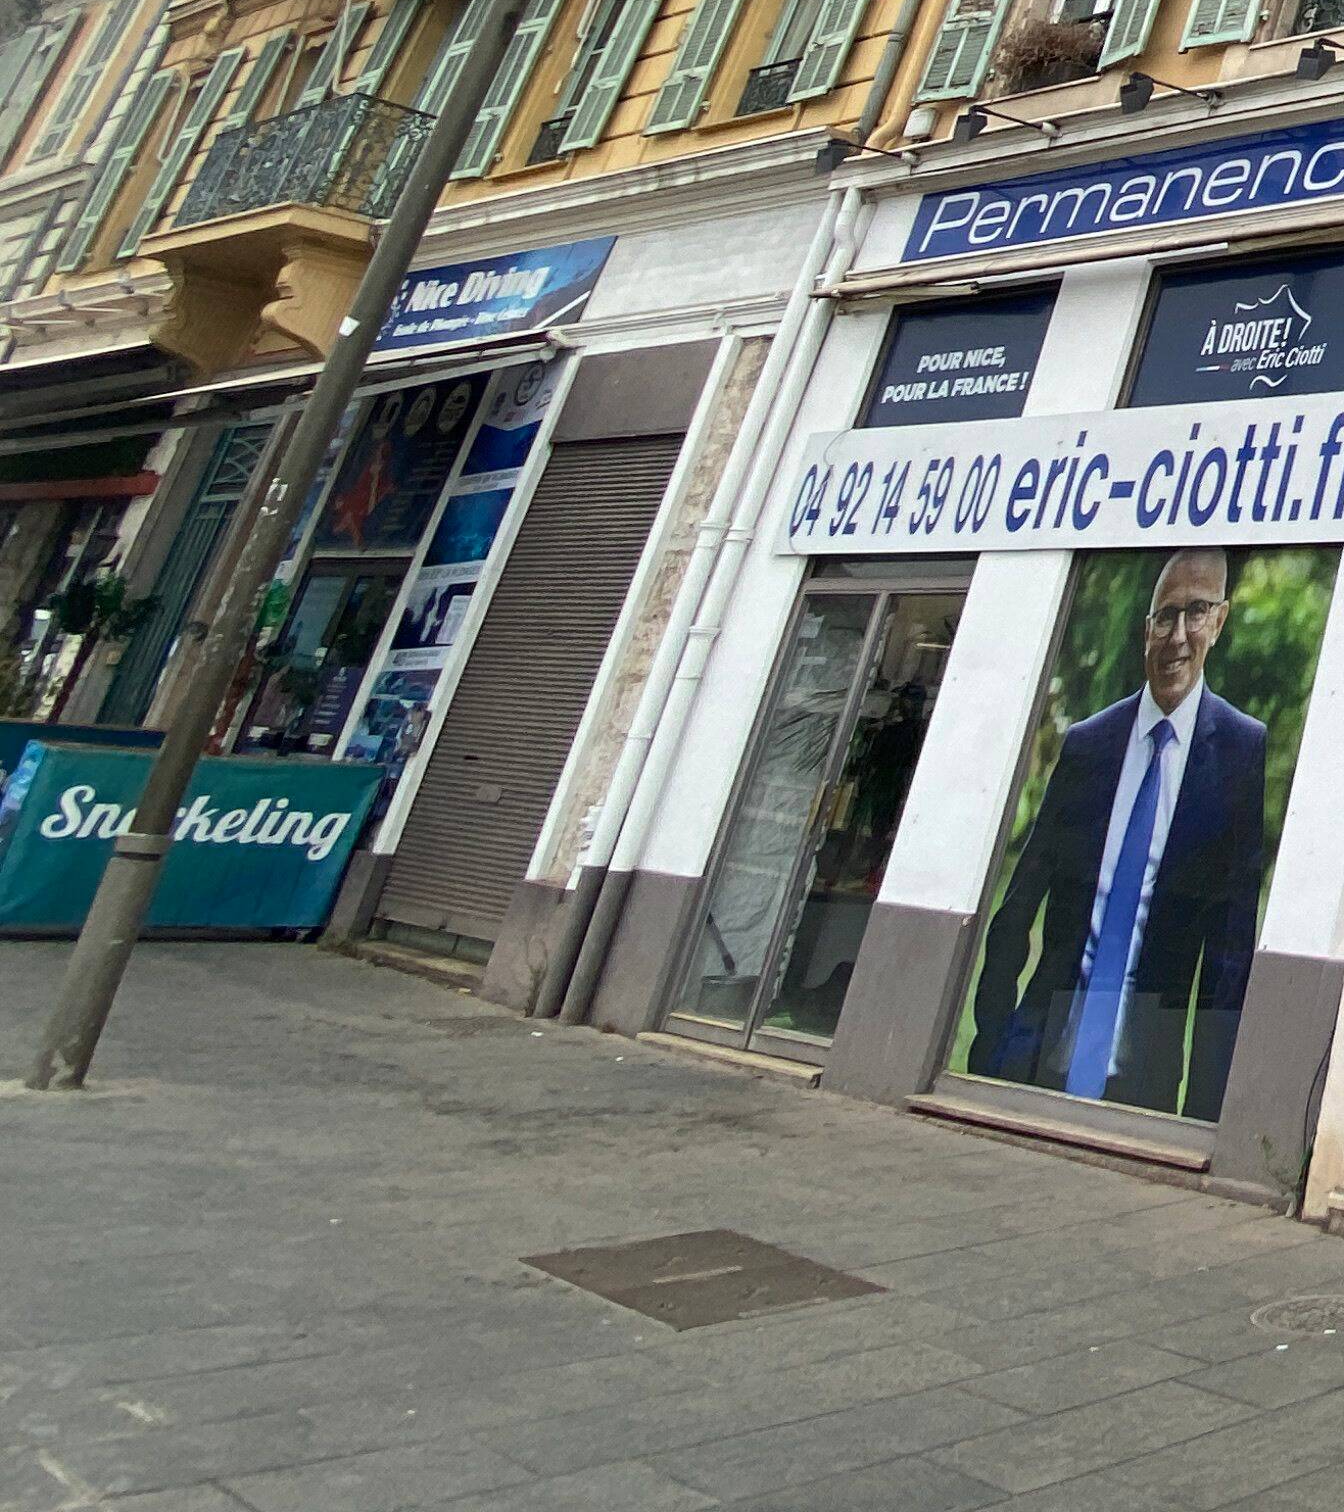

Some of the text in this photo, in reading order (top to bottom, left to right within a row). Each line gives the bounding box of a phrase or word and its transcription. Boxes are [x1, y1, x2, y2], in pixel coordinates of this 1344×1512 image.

[404, 266, 551, 313] Nice Diving
[1200, 320, 1218, 356] À
[917, 346, 1007, 374] POUR NICE,
[1230, 342, 1327, 372] avec Eric Ciotti
[881, 383, 928, 404] POUR
[927, 380, 949, 400] LA
[789, 464, 828, 538] 04
[828, 462, 875, 537] 92
[871, 460, 913, 536] 14
[908, 457, 956, 535] 59
[954, 454, 1002, 534] 00
[40, 785, 352, 861] Snkeling
